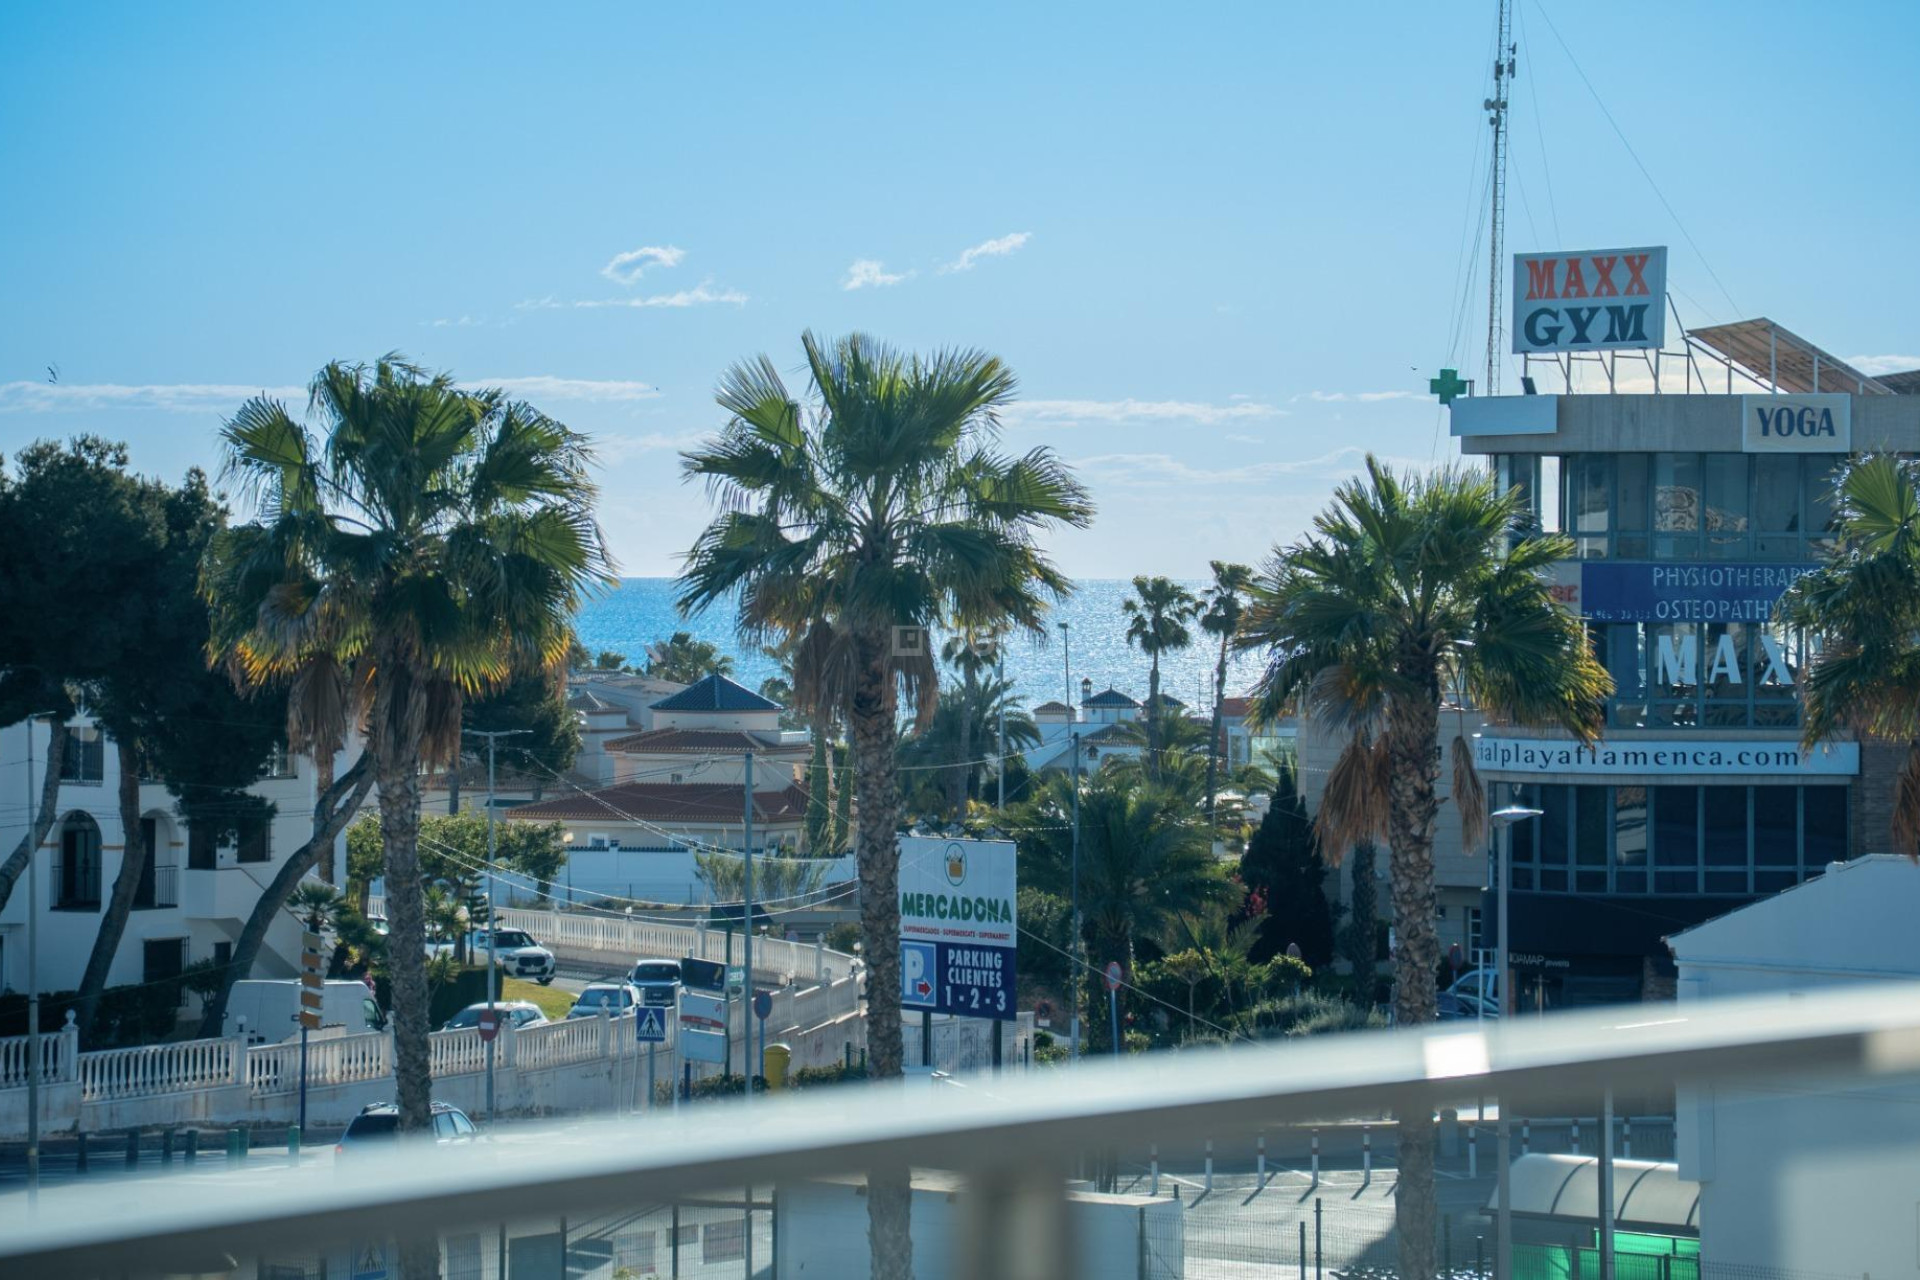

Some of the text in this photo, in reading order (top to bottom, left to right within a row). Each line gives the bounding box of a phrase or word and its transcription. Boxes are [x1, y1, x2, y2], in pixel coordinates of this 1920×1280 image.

[1527, 254, 1650, 299] MAXX
[1524, 304, 1649, 347] GYM
[1757, 407, 1836, 437] YOGA
[903, 892, 1012, 924] MERCADONA
[906, 949, 924, 995] P
[948, 949, 1003, 969] PARKING
[948, 968, 1002, 988] CLIENTES
